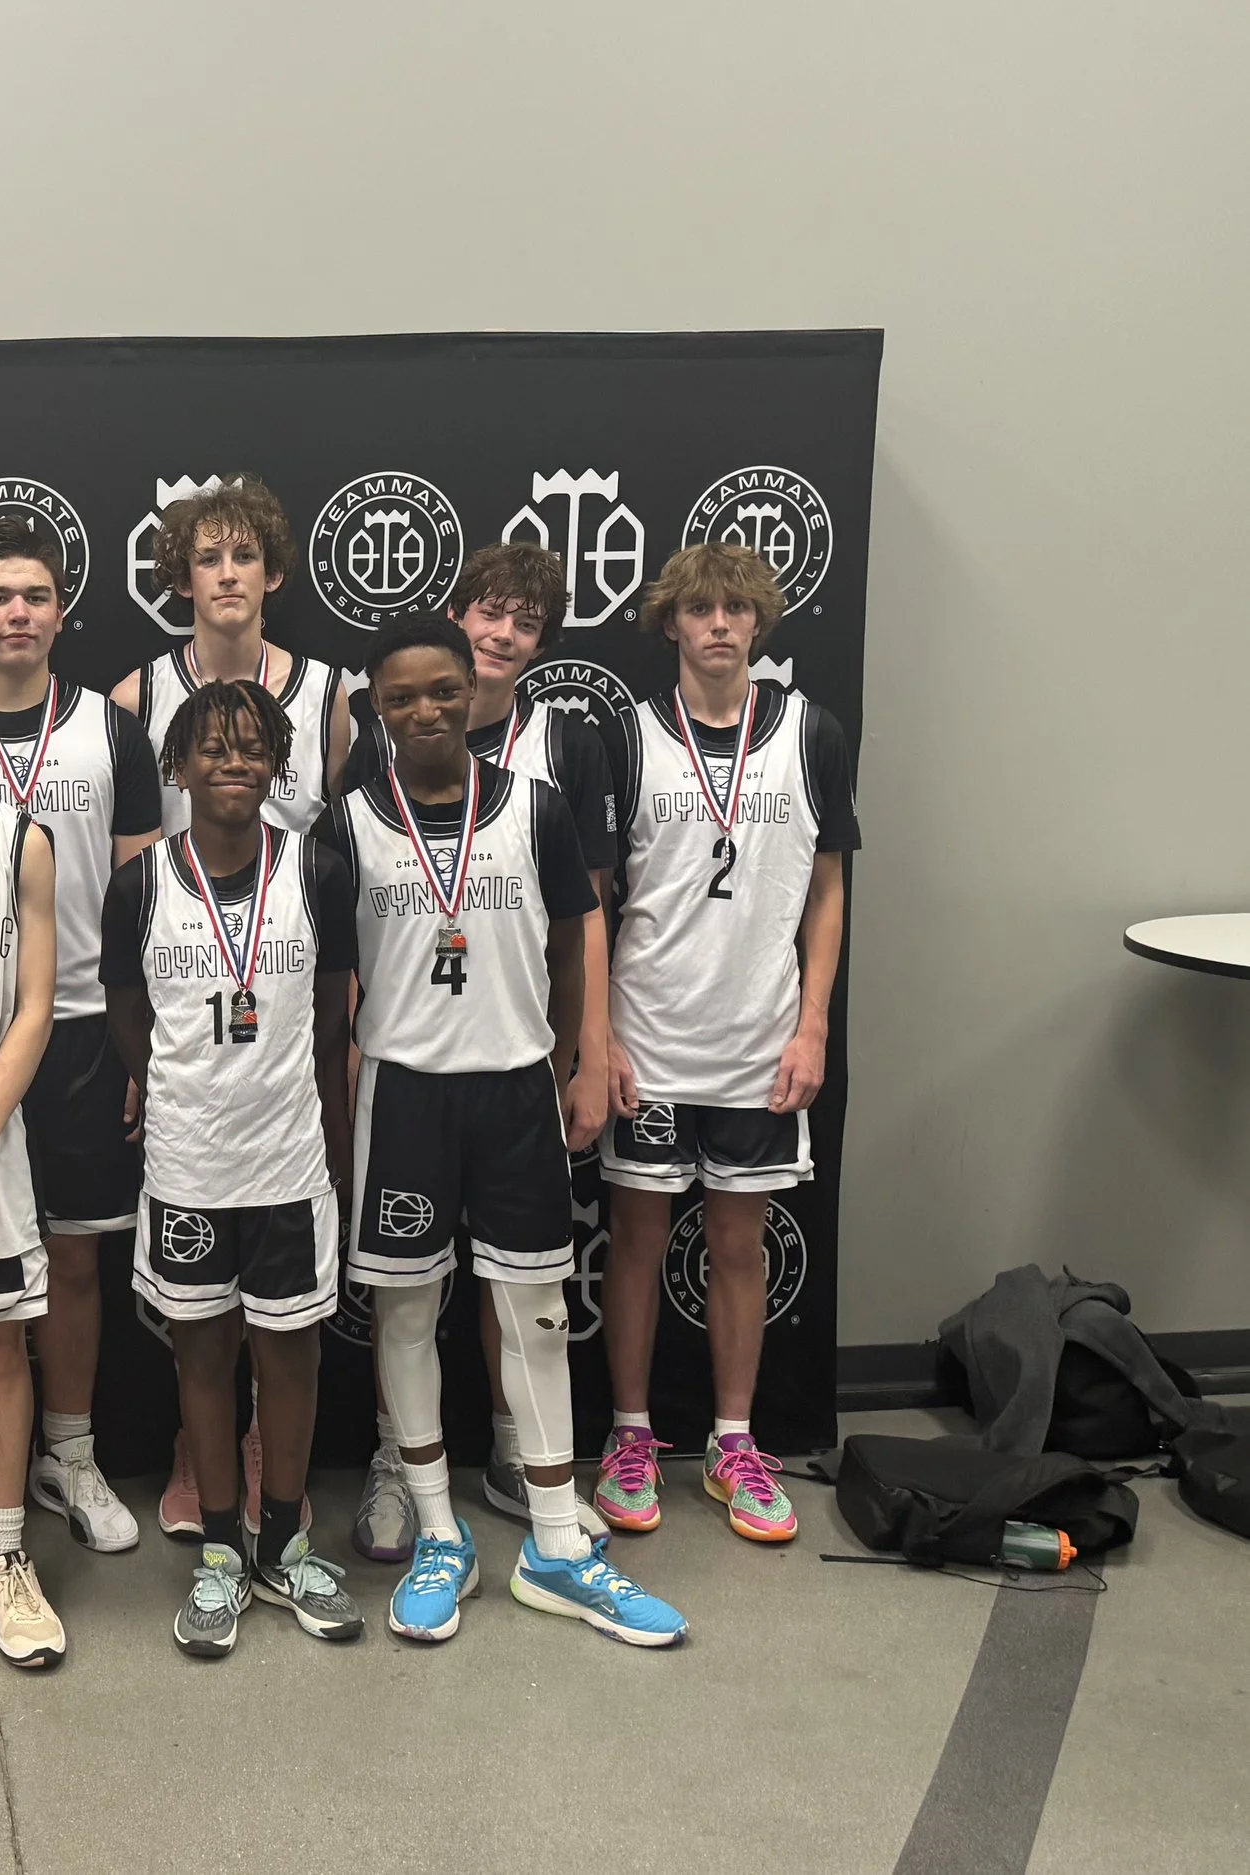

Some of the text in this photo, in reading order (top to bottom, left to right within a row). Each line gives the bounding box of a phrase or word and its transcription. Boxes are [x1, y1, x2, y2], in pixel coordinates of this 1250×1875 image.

[318, 478, 455, 539] TEAMMATE
[691, 473, 825, 531] TEAMMATE
[683, 771, 697, 779] CH
[653, 792, 790, 824] DYNMIC
[396, 852, 493, 869] CHS USA
[708, 837, 737, 900] 2
[369, 876, 523, 917] DYNMIC
[182, 921, 203, 931] CHS
[431, 953, 467, 996] 4
[671, 1265, 799, 1315] BASALL
